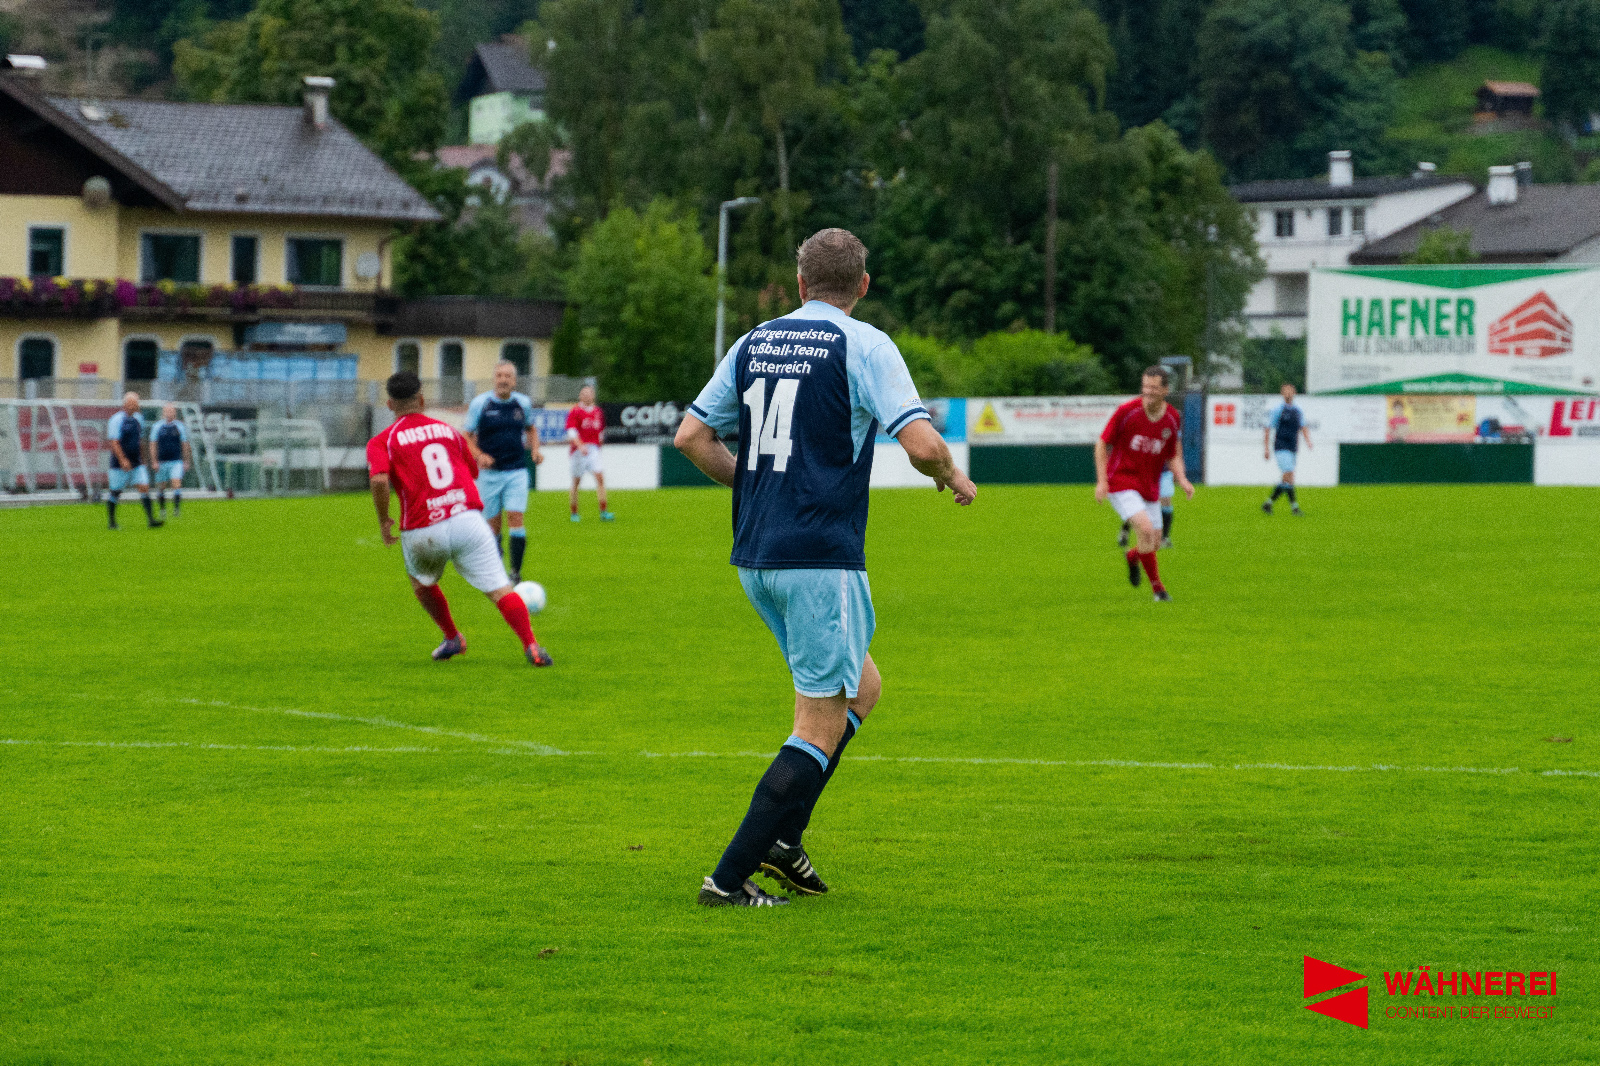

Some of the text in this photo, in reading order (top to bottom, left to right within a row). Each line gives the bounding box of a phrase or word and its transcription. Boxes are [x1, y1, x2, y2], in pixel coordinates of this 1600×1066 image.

[750, 328, 841, 343] Bürgermeister
[1340, 297, 1476, 337] HAFNER
[748, 357, 812, 374] Österreich
[396, 423, 455, 446] AUSTRIA
[743, 378, 800, 472] 14
[1549, 400, 1600, 437] LEI
[421, 443, 455, 490] 8
